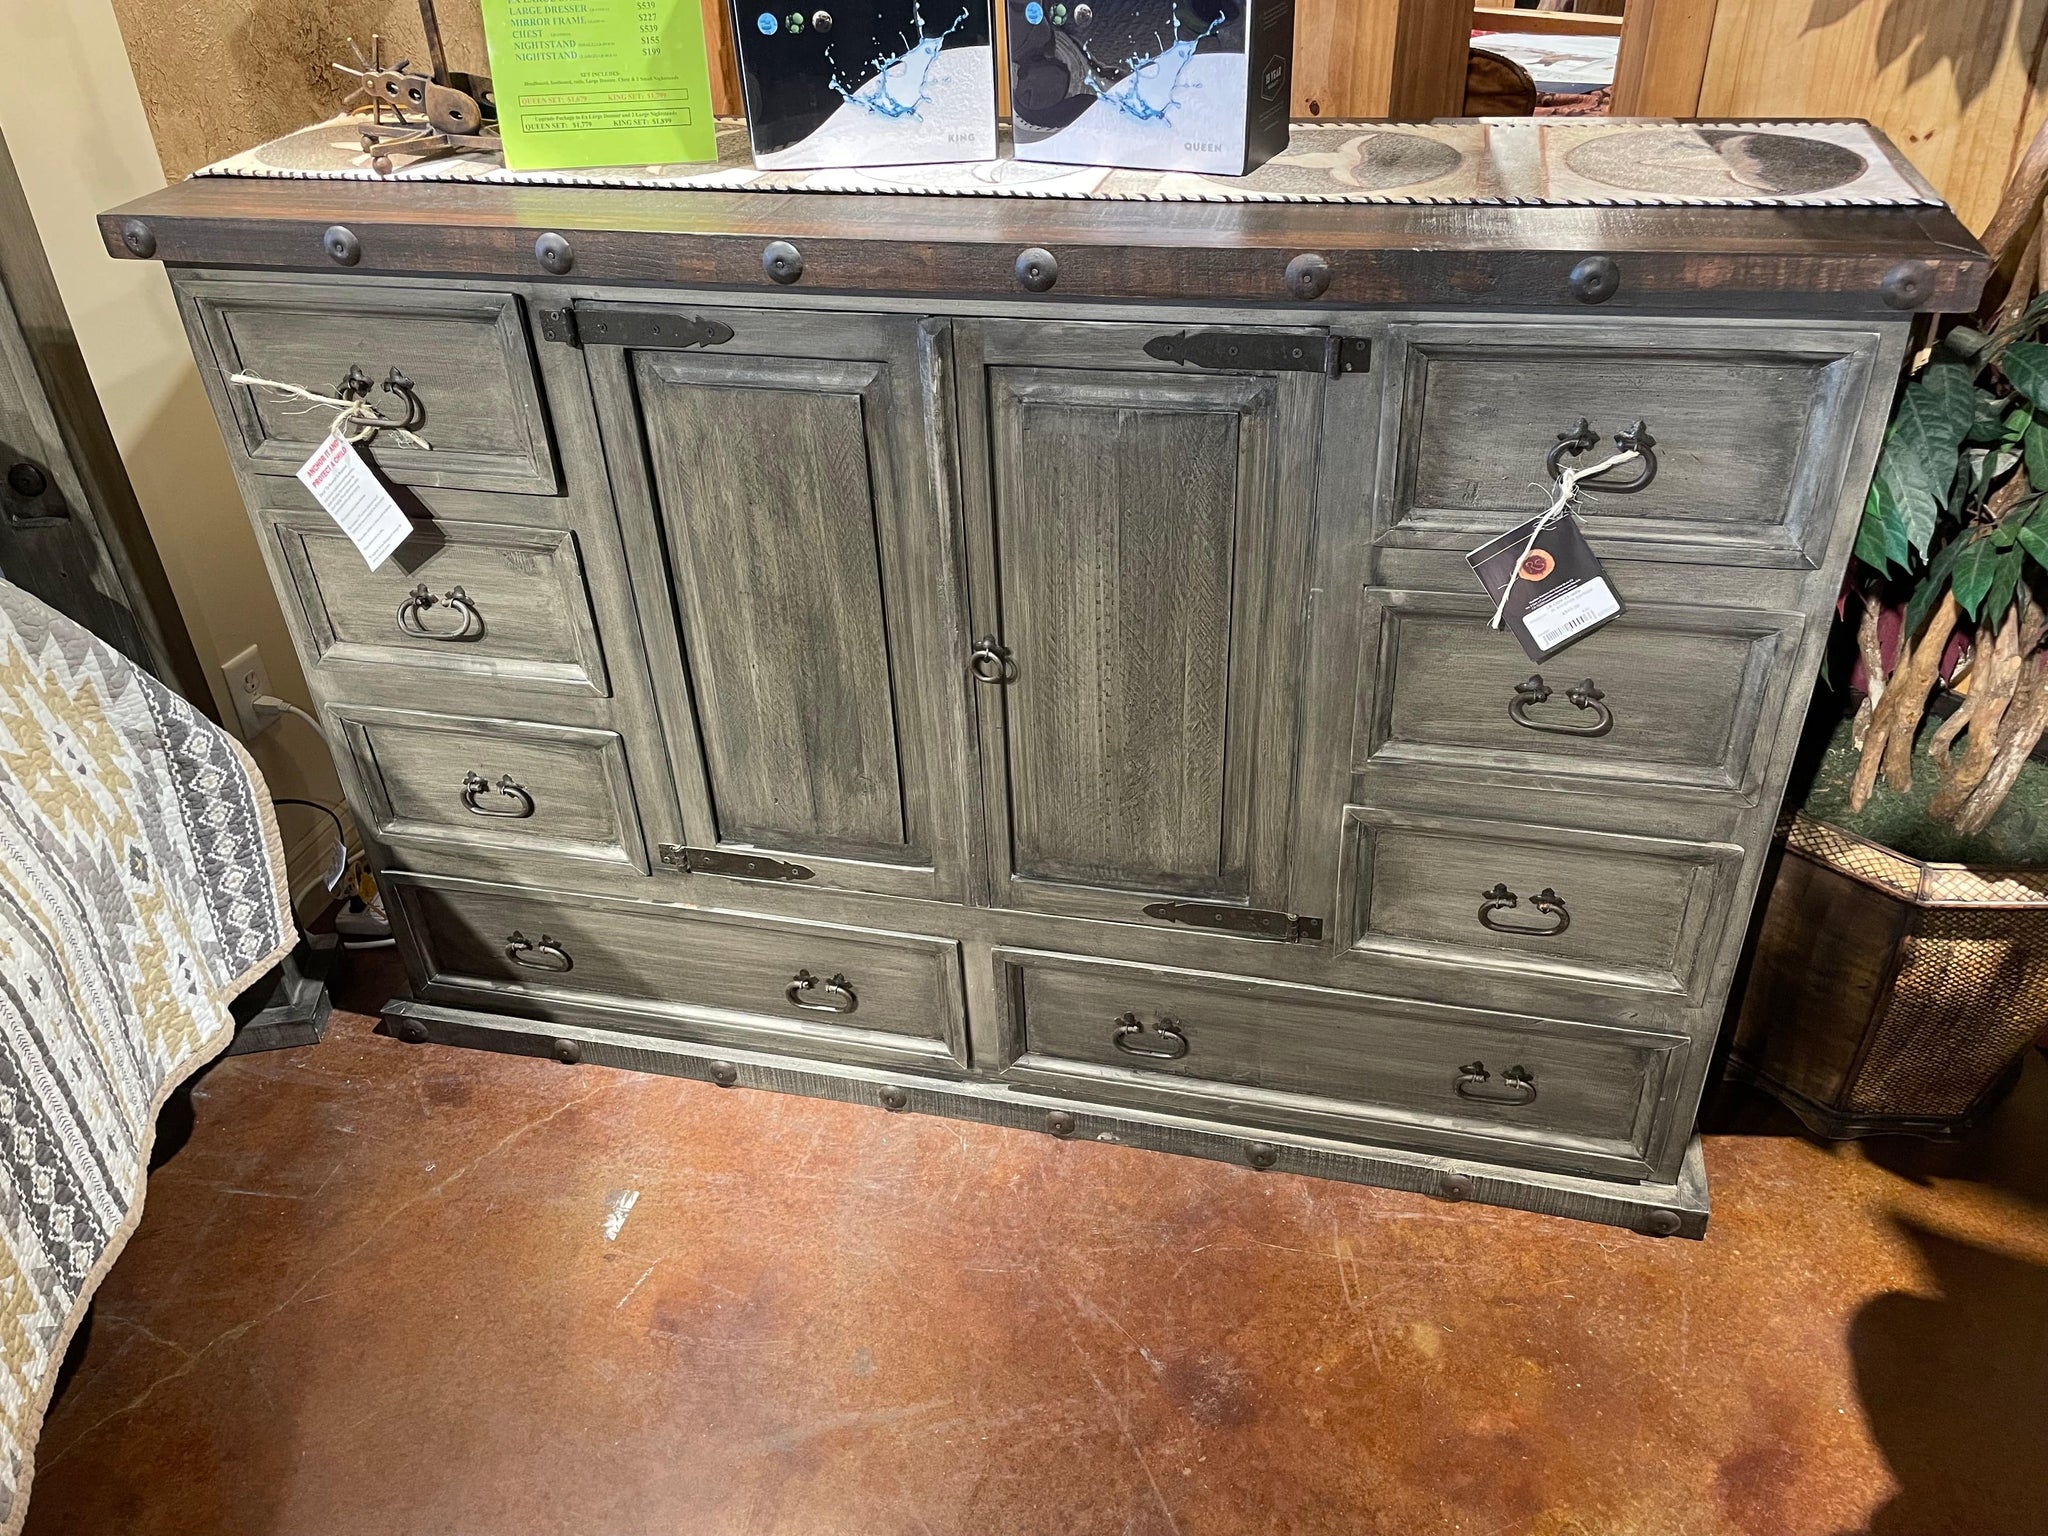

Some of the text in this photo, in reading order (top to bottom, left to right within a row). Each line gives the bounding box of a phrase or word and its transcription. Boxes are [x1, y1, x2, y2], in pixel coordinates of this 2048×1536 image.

[509, 6, 543, 15] LARGE
[545, 4, 588, 14] DRESSER
[637, 1, 656, 10] $539
[511, 18, 550, 27] MIRROR
[553, 16, 585, 25] FRAME
[638, 13, 657, 21] $227
[512, 29, 543, 39] CHEST
[639, 24, 658, 33] $539
[514, 39, 576, 50] NIGHTSTAND
[641, 36, 660, 45] $155
[515, 51, 577, 62] NIGHTSTAND
[642, 48, 661, 56] $199
[521, 97, 547, 105] QUEEN
[525, 123, 550, 131] QUEEN
[613, 119, 632, 127] KING
[948, 133, 975, 143] KING
[1185, 142, 1222, 152] QUEEN
[307, 455, 327, 478] ANCHOR
[329, 438, 340, 453] AND
[312, 465, 333, 488] PROTECT
[334, 446, 348, 464] CHILD
